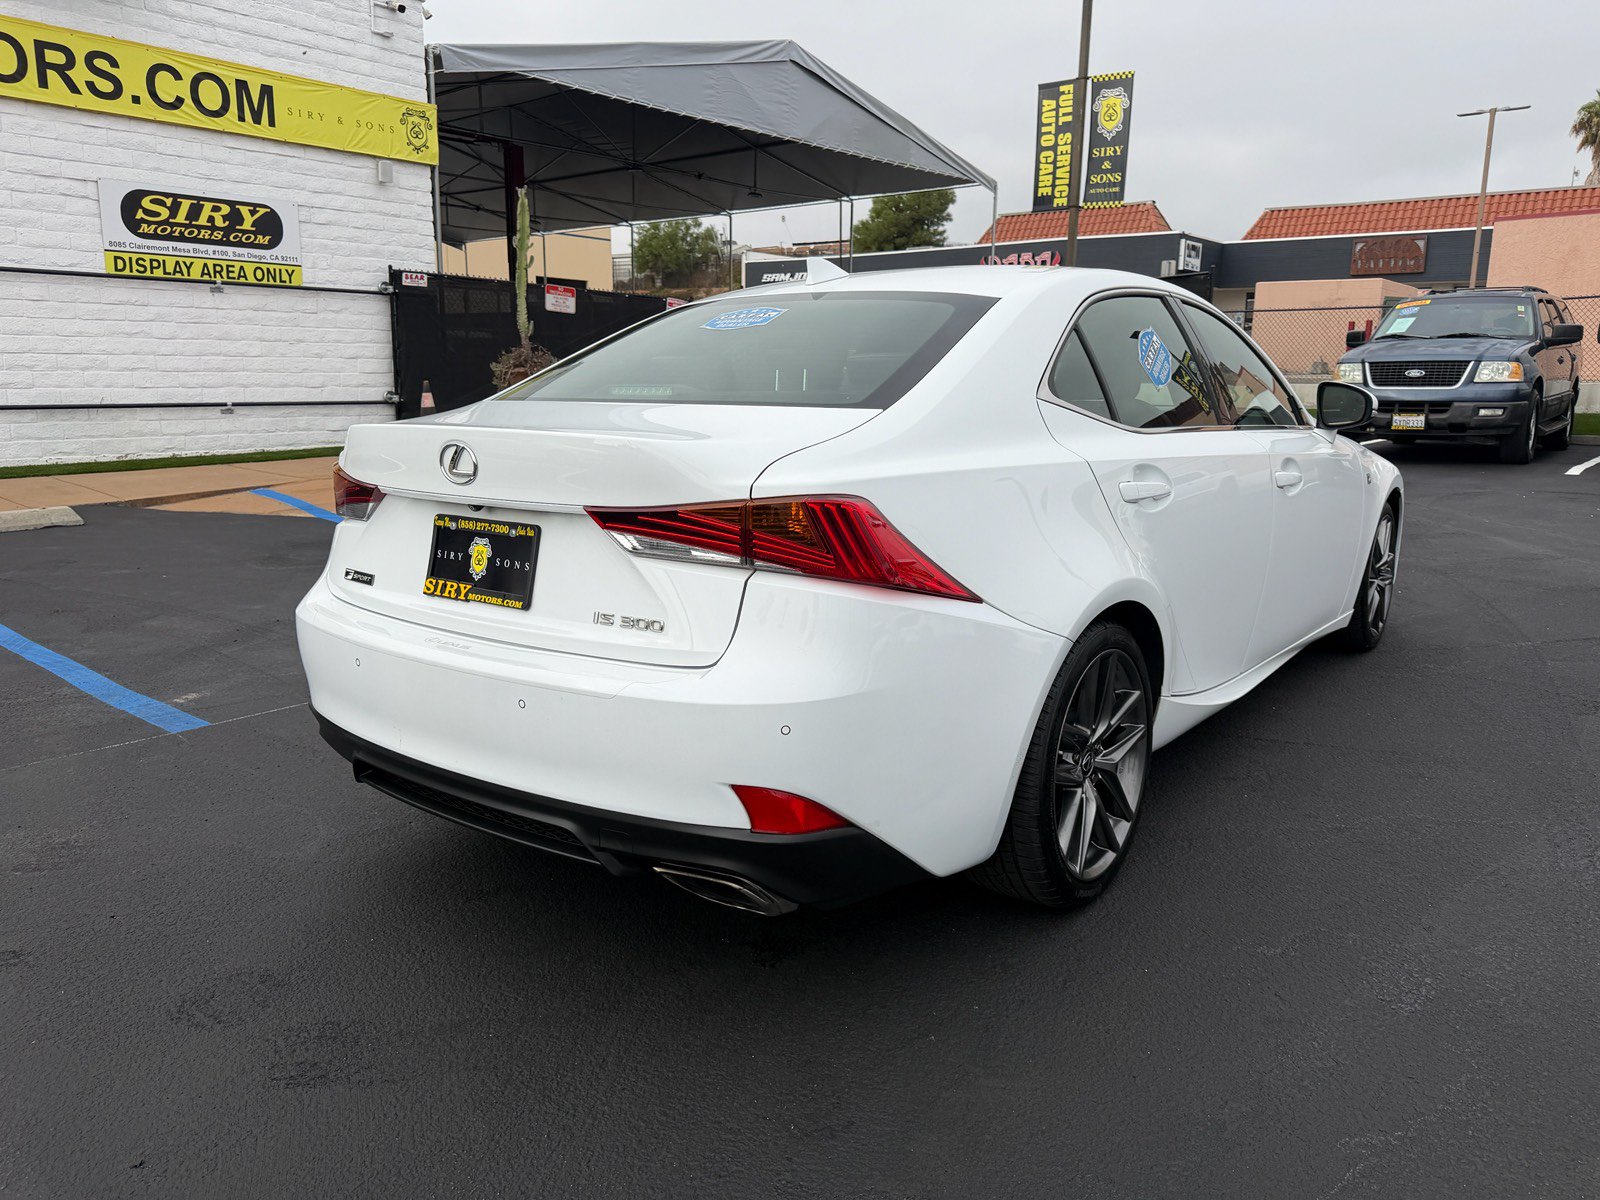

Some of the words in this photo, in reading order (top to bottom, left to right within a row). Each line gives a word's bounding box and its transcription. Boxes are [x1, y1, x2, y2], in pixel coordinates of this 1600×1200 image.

[1058, 84, 1074, 126] FULL
[287, 107, 325, 122] SIRY
[337, 116, 345, 125] &
[356, 119, 395, 134] SONS
[1040, 99, 1056, 147] AUTO
[1092, 145, 1124, 158] SIRY
[1037, 150, 1054, 197] CARE
[1053, 132, 1073, 208] SERVICE
[1101, 160, 1112, 170] &
[1089, 172, 1122, 184] SONS
[135, 194, 271, 231] SIRY
[137, 223, 272, 245] MOTORS.COM
[108, 240, 127, 248] 8085
[128, 242, 170, 252] Clairemont
[171, 246, 191, 254] Mesa
[113, 255, 194, 277] DISPLAY
[200, 262, 248, 281] AREA
[253, 266, 296, 284] ONLY
[476, 521, 510, 534] 277-7300
[436, 549, 463, 561] SIRY
[495, 557, 530, 571] SONS
[423, 577, 472, 600] SIRY
[467, 593, 524, 609] MOTORS.COM
[593, 611, 615, 626] IS
[619, 615, 665, 633] 300
